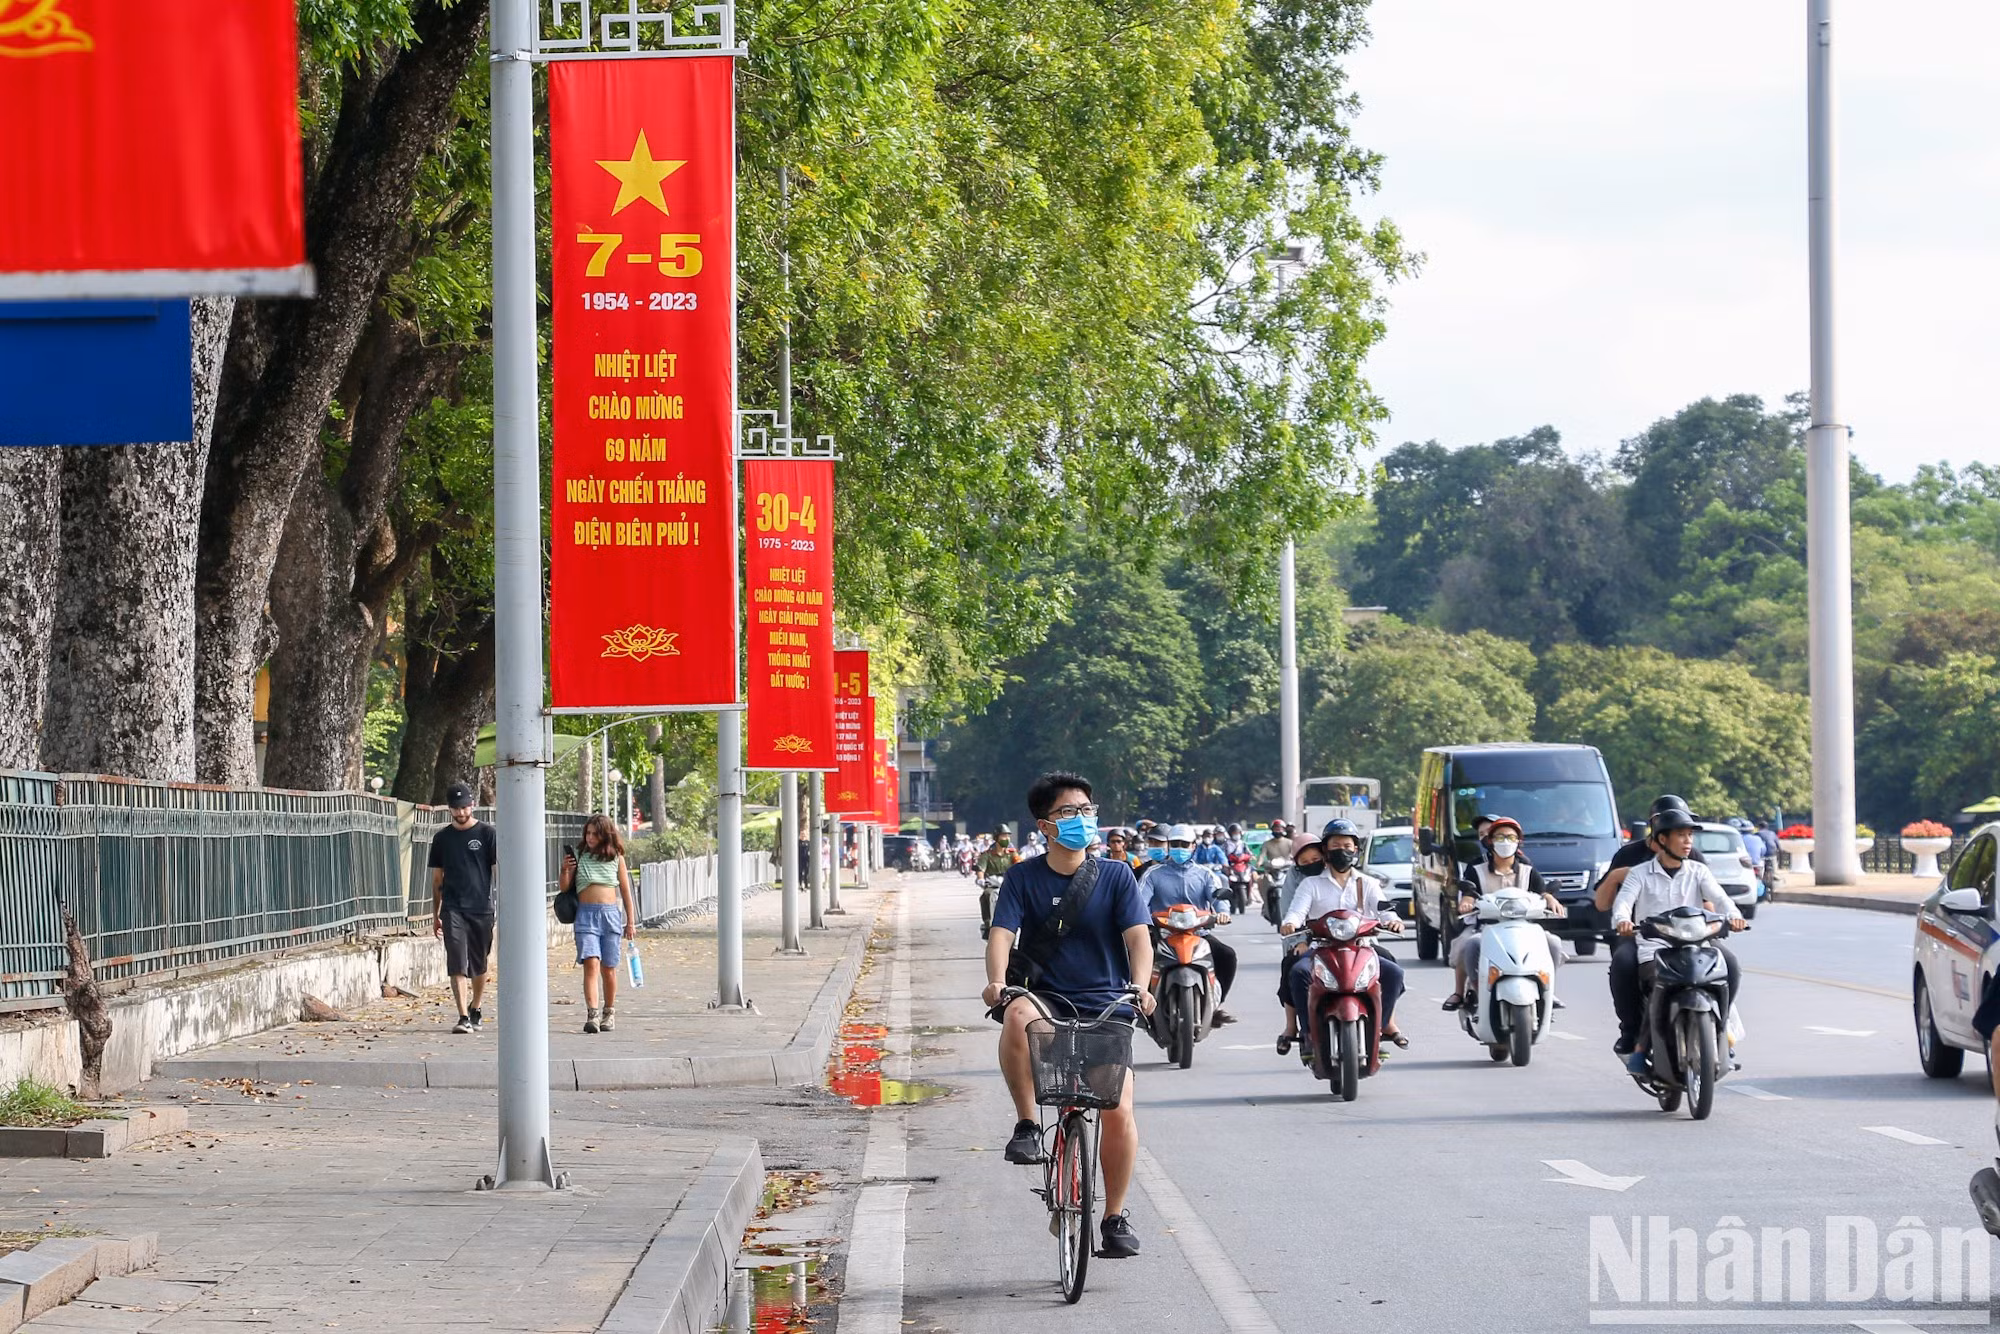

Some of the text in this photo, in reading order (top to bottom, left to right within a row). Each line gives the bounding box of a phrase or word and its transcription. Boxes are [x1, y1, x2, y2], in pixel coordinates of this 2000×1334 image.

[576, 233, 704, 278] 7-5
[581, 292, 630, 310] 1954
[648, 292, 698, 310] 2023
[594, 349, 677, 383] NHIỆT LIỆT
[588, 389, 684, 420] CHÀO MỪNG
[605, 433, 667, 462] 69 NĂM
[566, 472, 706, 504] NGÀY CHIẾN THẮNG
[756, 492, 817, 535] 30-4
[574, 516, 611, 551] ĐIỆN
[615, 517, 653, 546] BIÊN
[656, 511, 689, 546] PHỦ
[758, 537, 782, 549] 1975
[790, 539, 815, 552] 2023
[769, 565, 806, 586] NHIỆT LIỆT
[754, 586, 773, 603] CHÀO
[773, 586, 795, 604] MỪNG
[806, 589, 823, 606] NĂM
[758, 605, 819, 627] NGÀY GIẢI PHÓNG
[768, 648, 811, 669] THỐNG NHẤT
